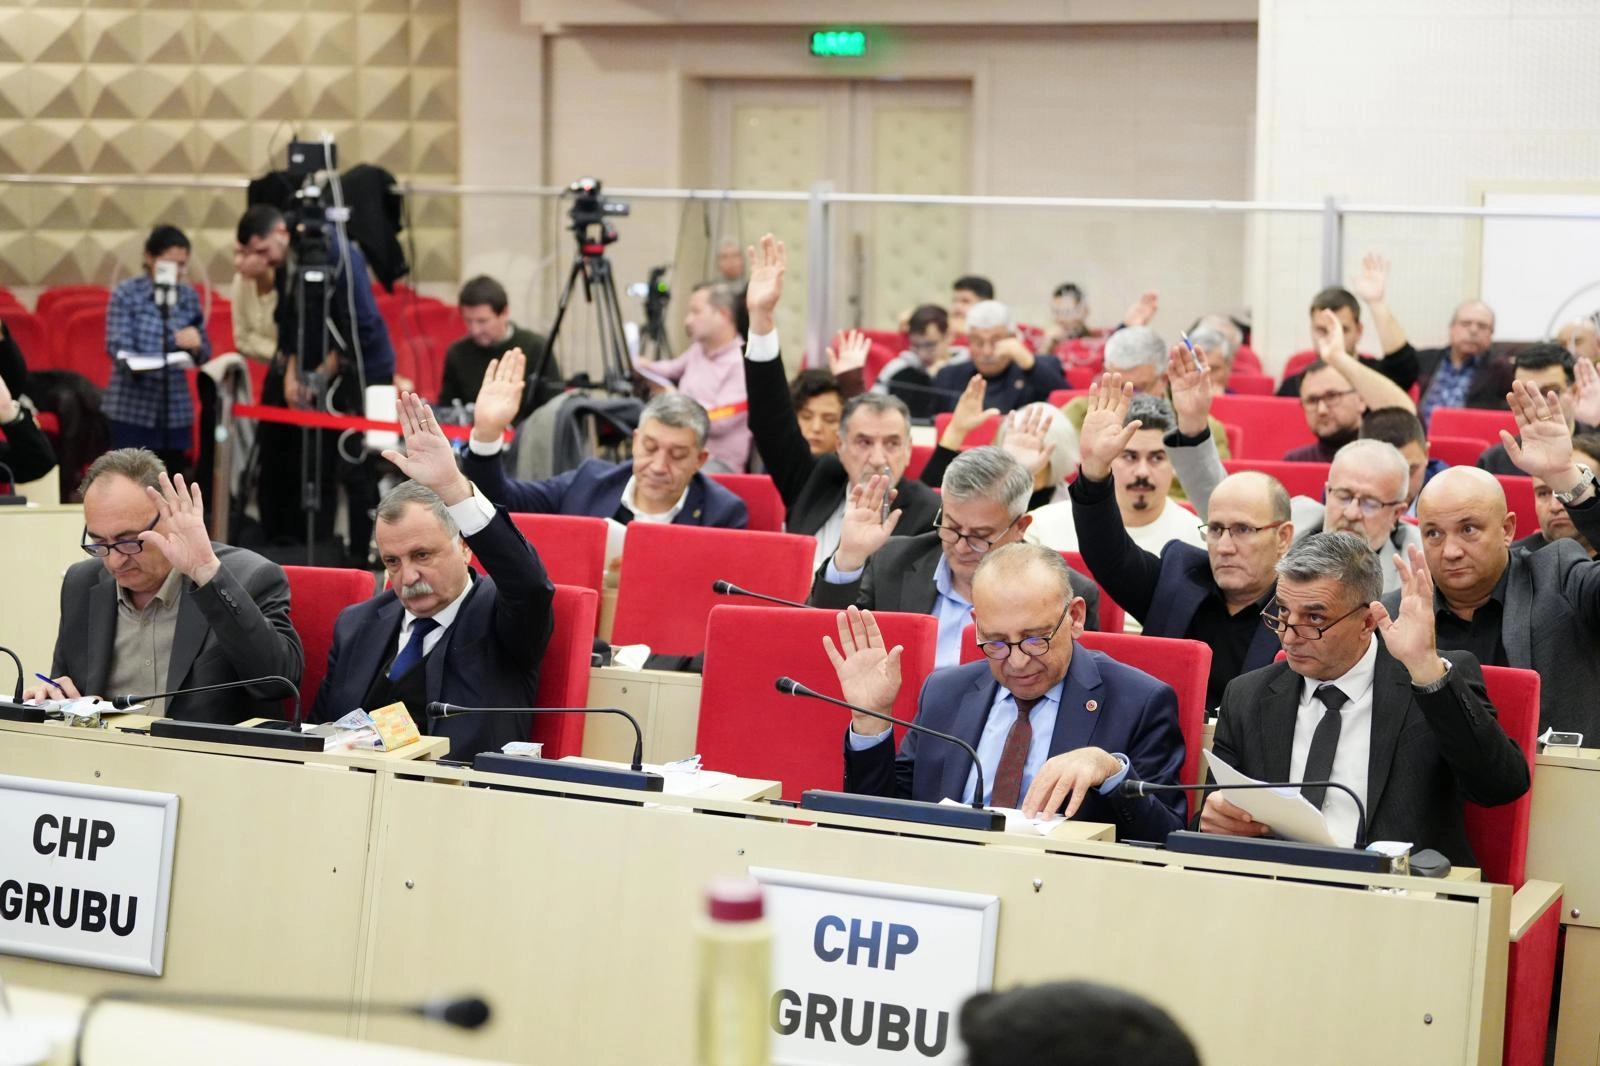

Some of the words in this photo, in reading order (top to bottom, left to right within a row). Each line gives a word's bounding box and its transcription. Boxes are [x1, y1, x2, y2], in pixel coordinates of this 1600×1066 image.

[33, 813, 115, 861] CHP
[0, 879, 138, 936] GRUBU
[813, 915, 919, 971] CHP
[769, 988, 949, 1057] GRUBU
